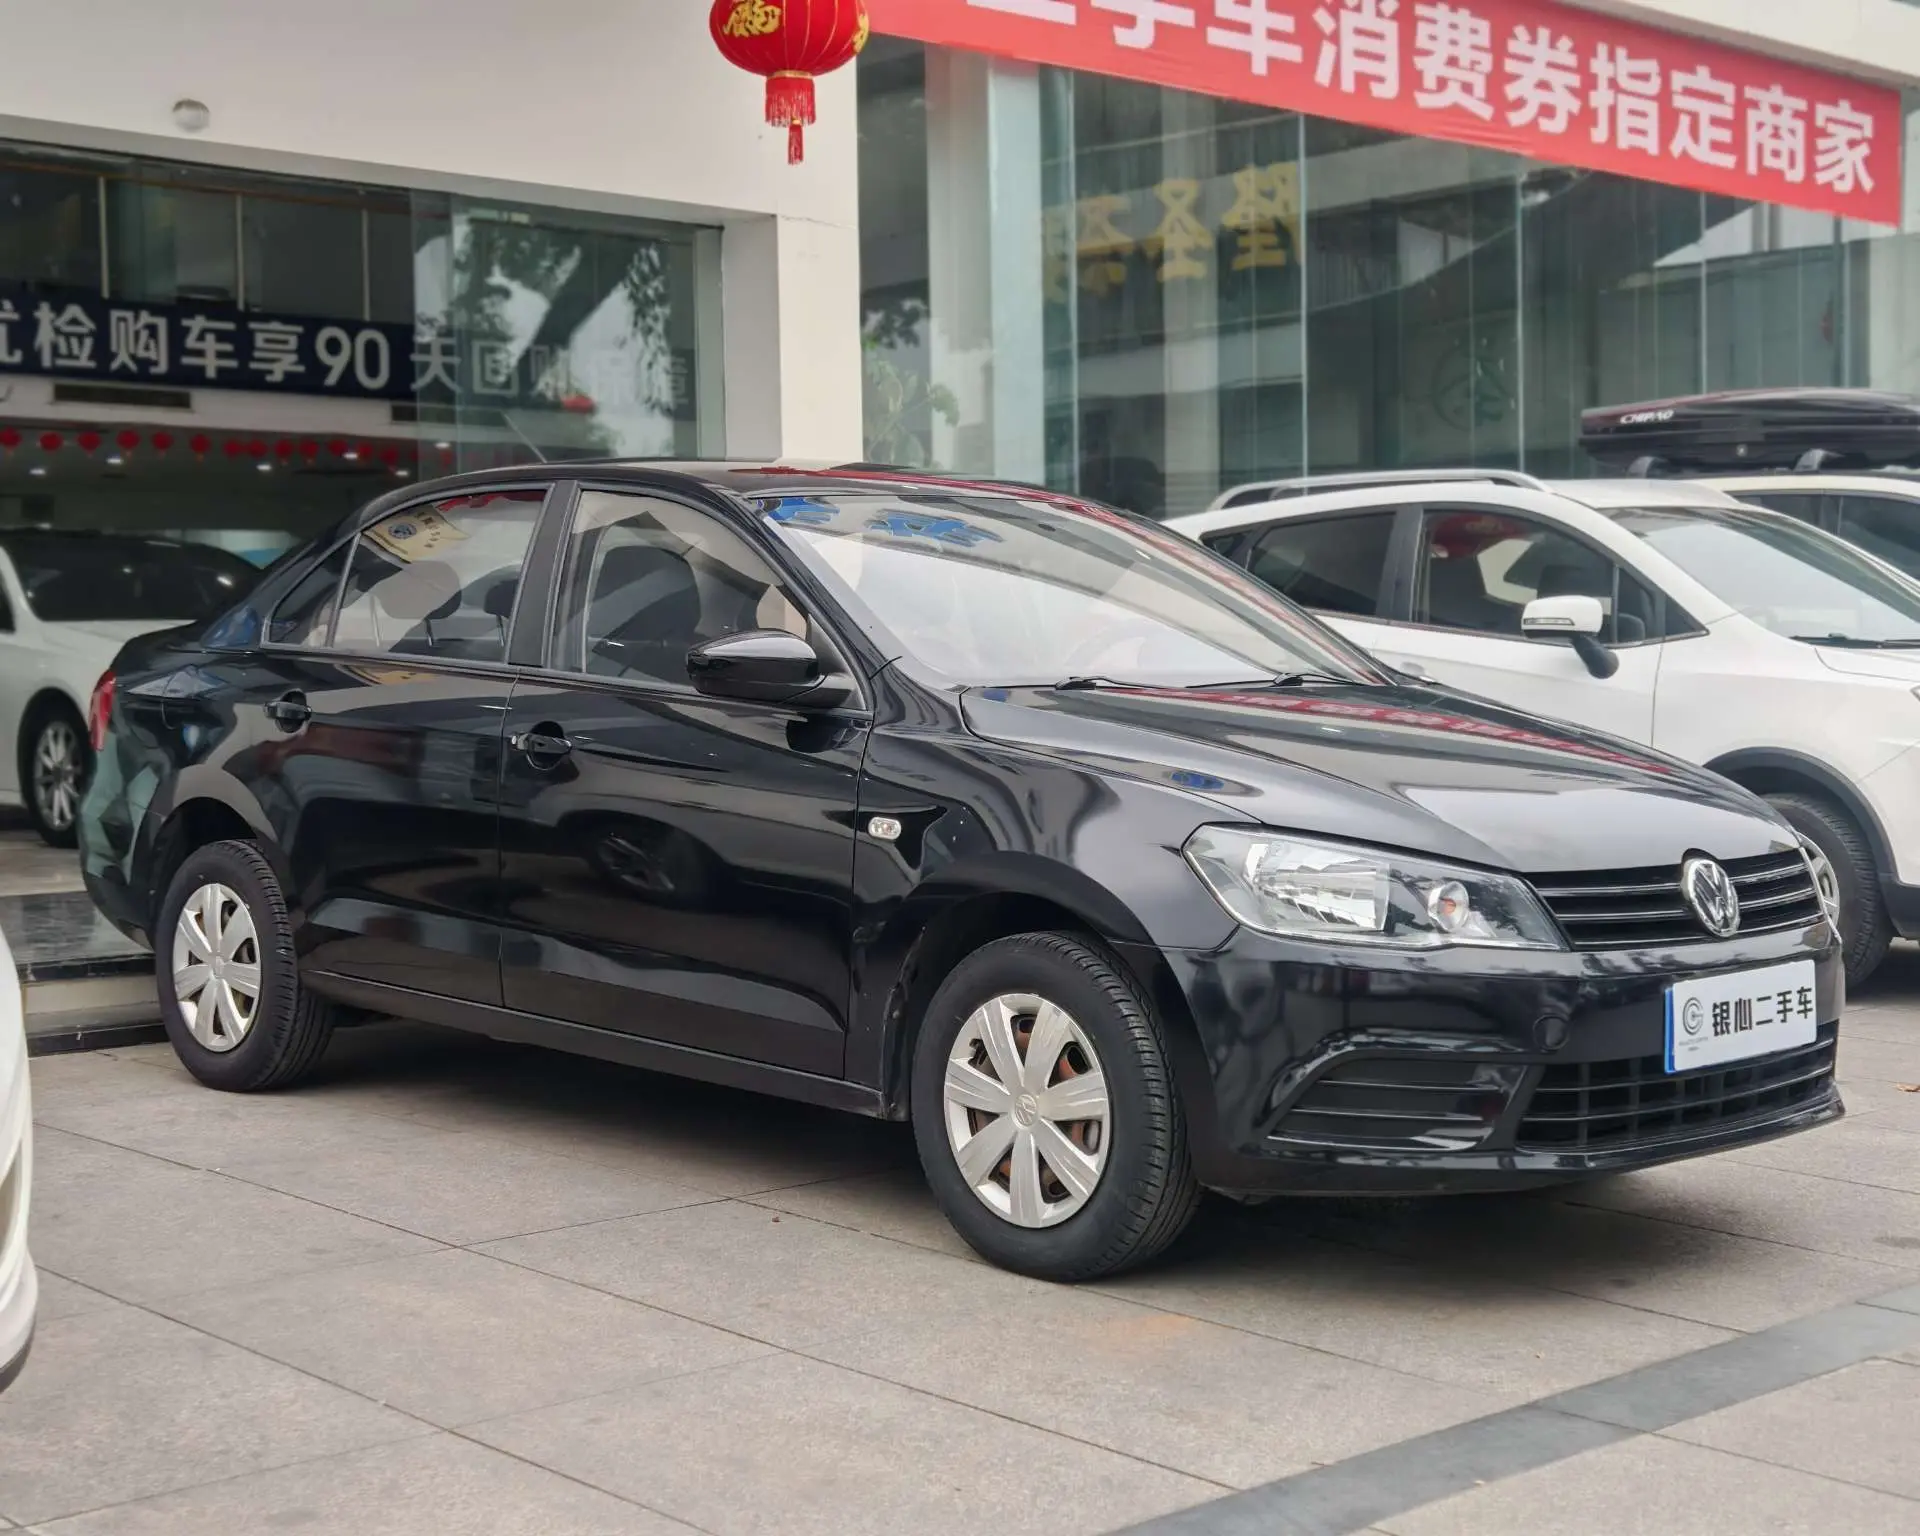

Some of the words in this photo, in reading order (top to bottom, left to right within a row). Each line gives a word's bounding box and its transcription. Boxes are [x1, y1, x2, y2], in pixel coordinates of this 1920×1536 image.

[1712, 986, 1814, 1036] 银心二手车
